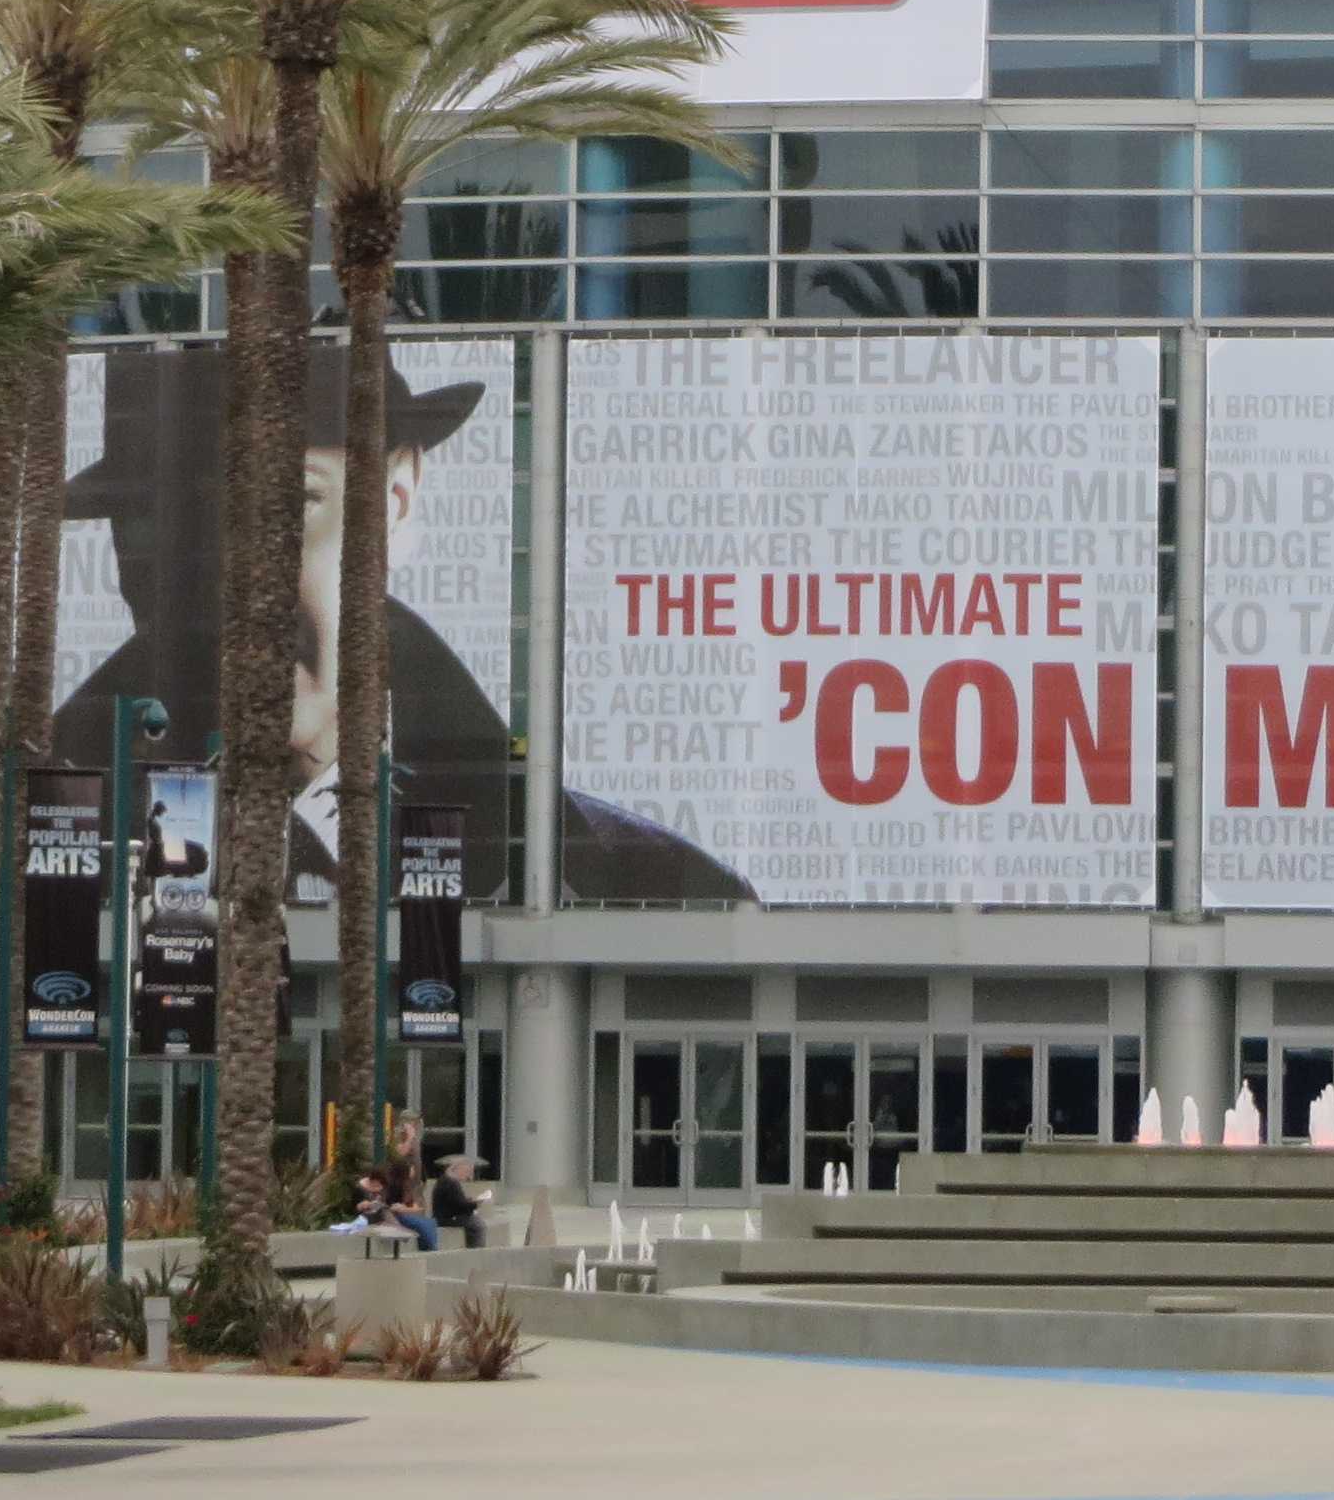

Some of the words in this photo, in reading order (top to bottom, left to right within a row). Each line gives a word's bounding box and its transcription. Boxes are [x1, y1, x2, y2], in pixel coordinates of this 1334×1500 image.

[634, 339, 730, 387] THE
[748, 336, 1121, 386] FREELANCER
[606, 391, 731, 419] GENERAL
[742, 391, 816, 418] LUDD
[1012, 393, 1060, 417] THE
[572, 423, 757, 464] GARRICK
[767, 422, 856, 459] GINA
[868, 421, 1089, 459] ZANETAKOS
[620, 492, 829, 528] ALCHEMIST
[843, 492, 932, 522] MAKO
[945, 493, 1054, 522] TANIDA
[584, 533, 812, 569] STEWMAKER
[827, 528, 904, 566] THE
[919, 527, 1098, 567] COURIER
[1224, 574, 1296, 597] PRATT
[615, 572, 738, 637] THE
[759, 572, 1083, 637] ULTIMATE
[619, 643, 756, 677] WUJING
[610, 682, 747, 717] AGENCY
[624, 721, 763, 764] PRATT
[670, 768, 796, 792] BROTHERS
[28, 830, 100, 846] POPULAR
[712, 820, 838, 848] GENERAL
[851, 820, 926, 848] LUDD
[933, 810, 994, 843] THE
[25, 847, 101, 876] ARTS
[748, 853, 848, 880] BOBBIT
[857, 854, 986, 877] FREDERICK
[995, 854, 1088, 878] BARNES
[1094, 850, 1153, 878] THE
[401, 872, 462, 897] ARTS
[145, 933, 214, 950] Rosemary's
